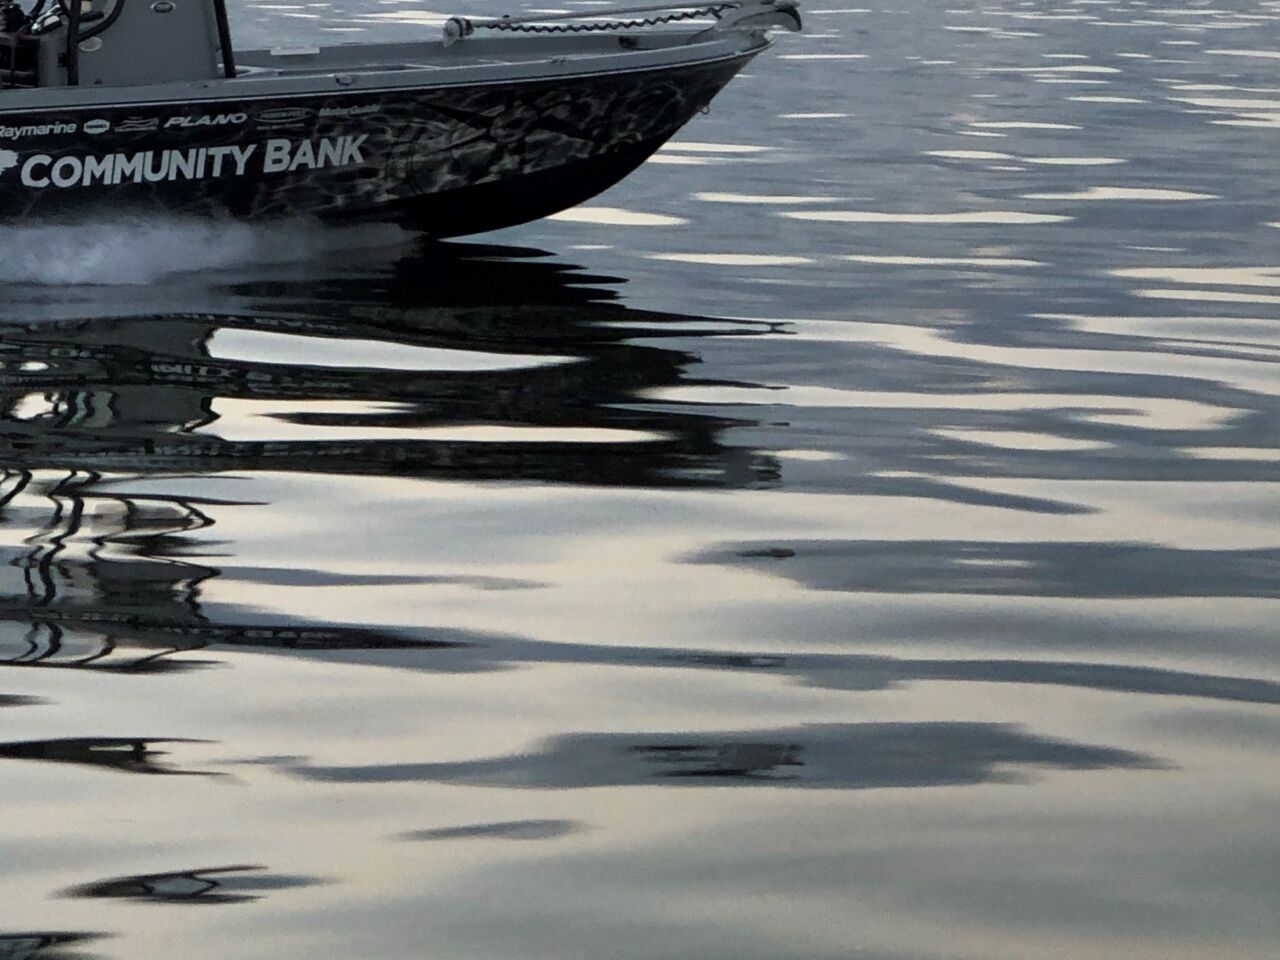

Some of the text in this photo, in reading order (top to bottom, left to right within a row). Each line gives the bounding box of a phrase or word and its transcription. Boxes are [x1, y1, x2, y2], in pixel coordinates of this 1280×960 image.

[163, 112, 248, 128] PLANO
[20, 134, 369, 188] COMMUNITY BANK
